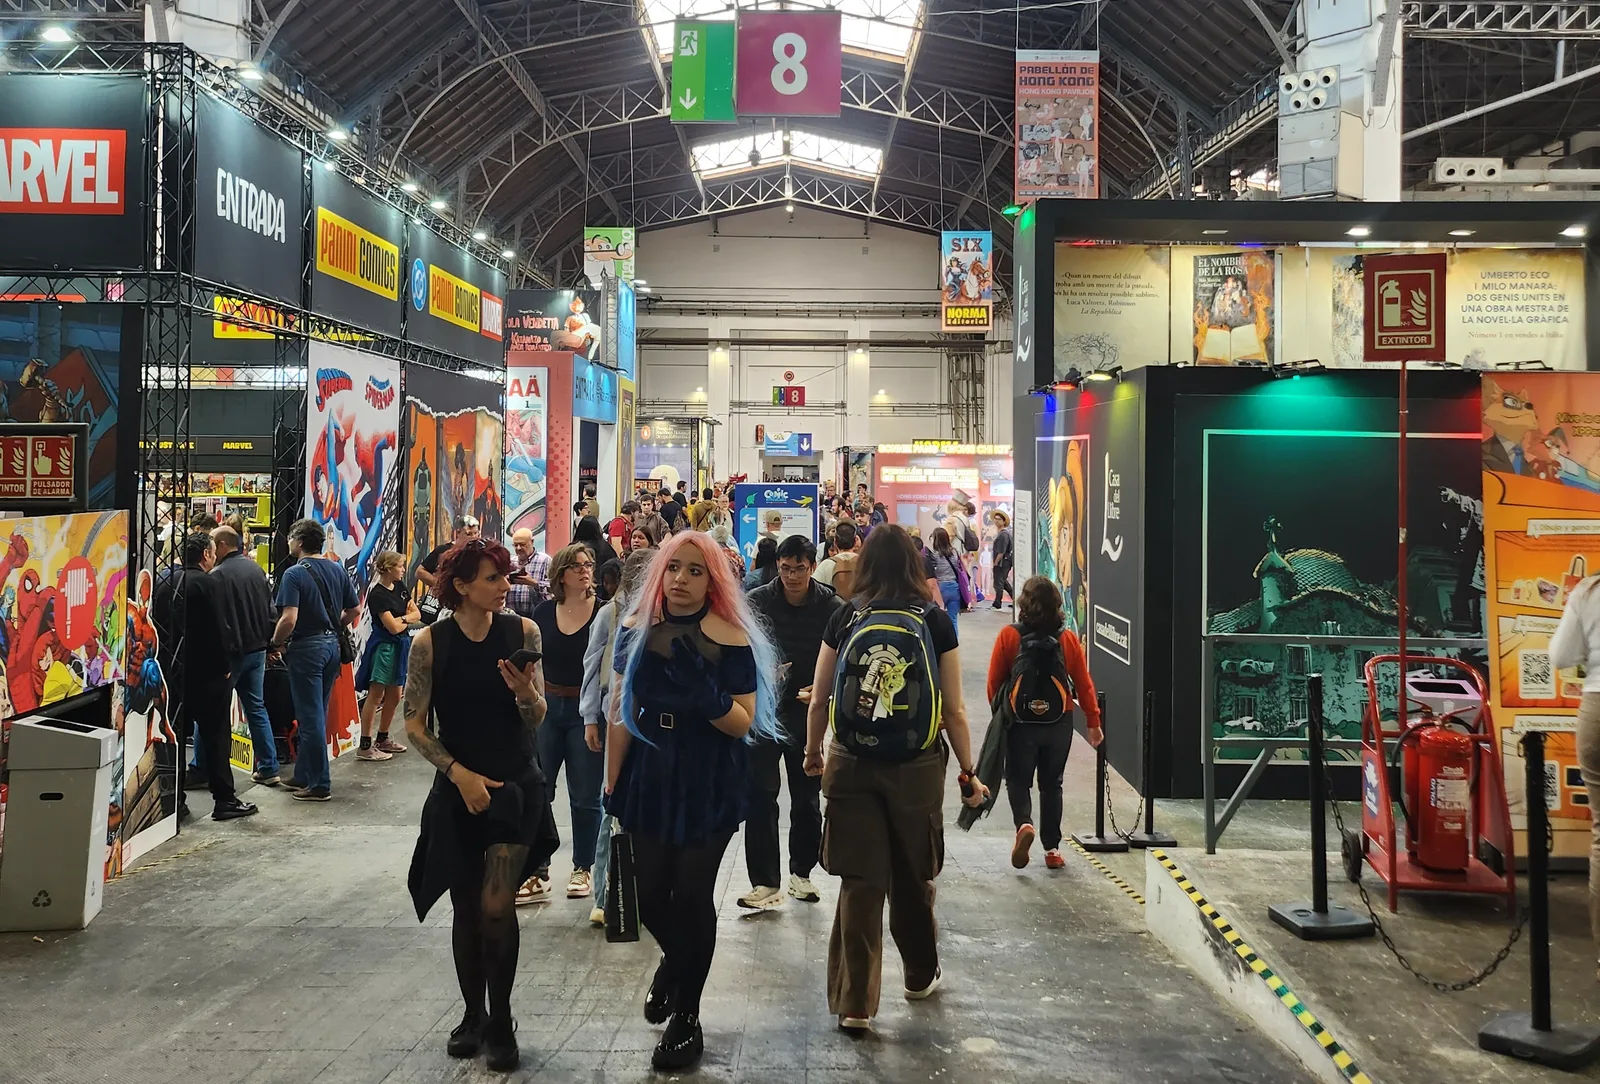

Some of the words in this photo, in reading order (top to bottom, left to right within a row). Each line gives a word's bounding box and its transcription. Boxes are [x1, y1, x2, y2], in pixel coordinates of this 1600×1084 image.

[771, 32, 808, 95] 8
[1080, 66, 1094, 74] DE
[1019, 76, 1055, 86] HONG
[1058, 76, 1095, 86] KONG
[217, 167, 286, 244] ENTRADA
[951, 237, 983, 252] SIX
[1198, 258, 1209, 267] EL
[1198, 266, 1210, 276] DE
[1212, 266, 1223, 276] LA
[1480, 271, 1528, 279] UMBERTO
[1530, 271, 1550, 279] ECO
[946, 307, 987, 318] NORMA
[1381, 336, 1427, 344] EXTINTOR
[791, 390, 799, 402] 8
